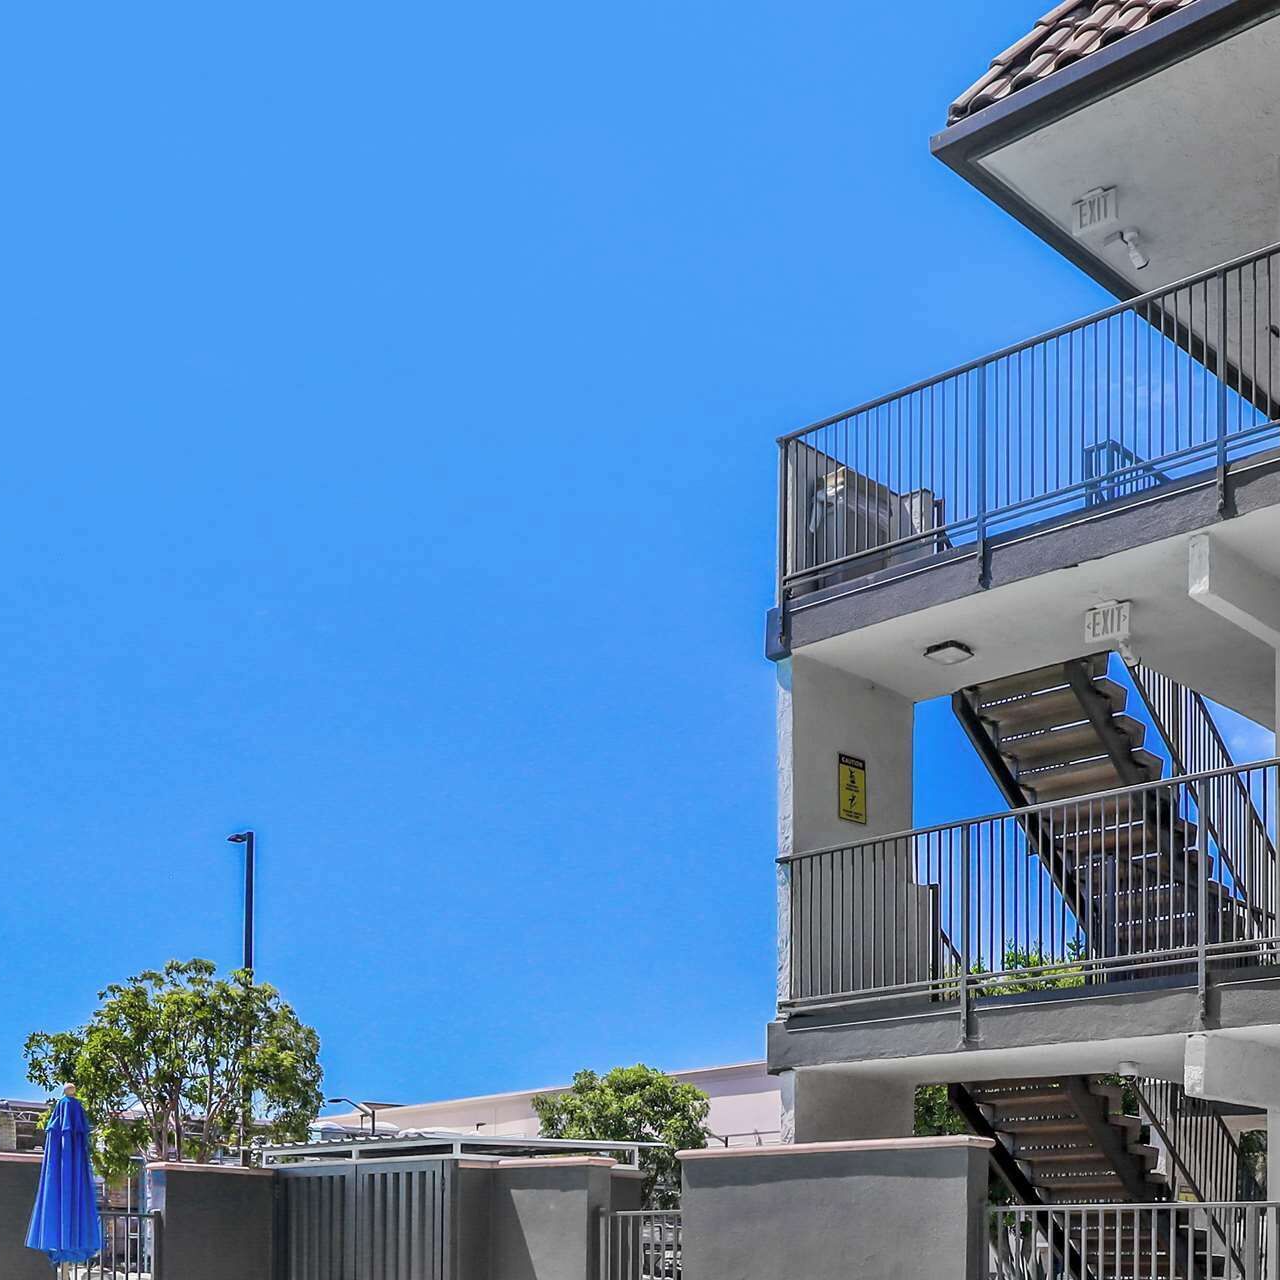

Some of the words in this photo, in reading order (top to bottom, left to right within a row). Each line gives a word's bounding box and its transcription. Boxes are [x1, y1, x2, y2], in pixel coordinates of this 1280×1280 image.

[1079, 194, 1110, 229] EXIT
[1092, 606, 1124, 637] EXIT
[841, 756, 864, 768] CAUTION
